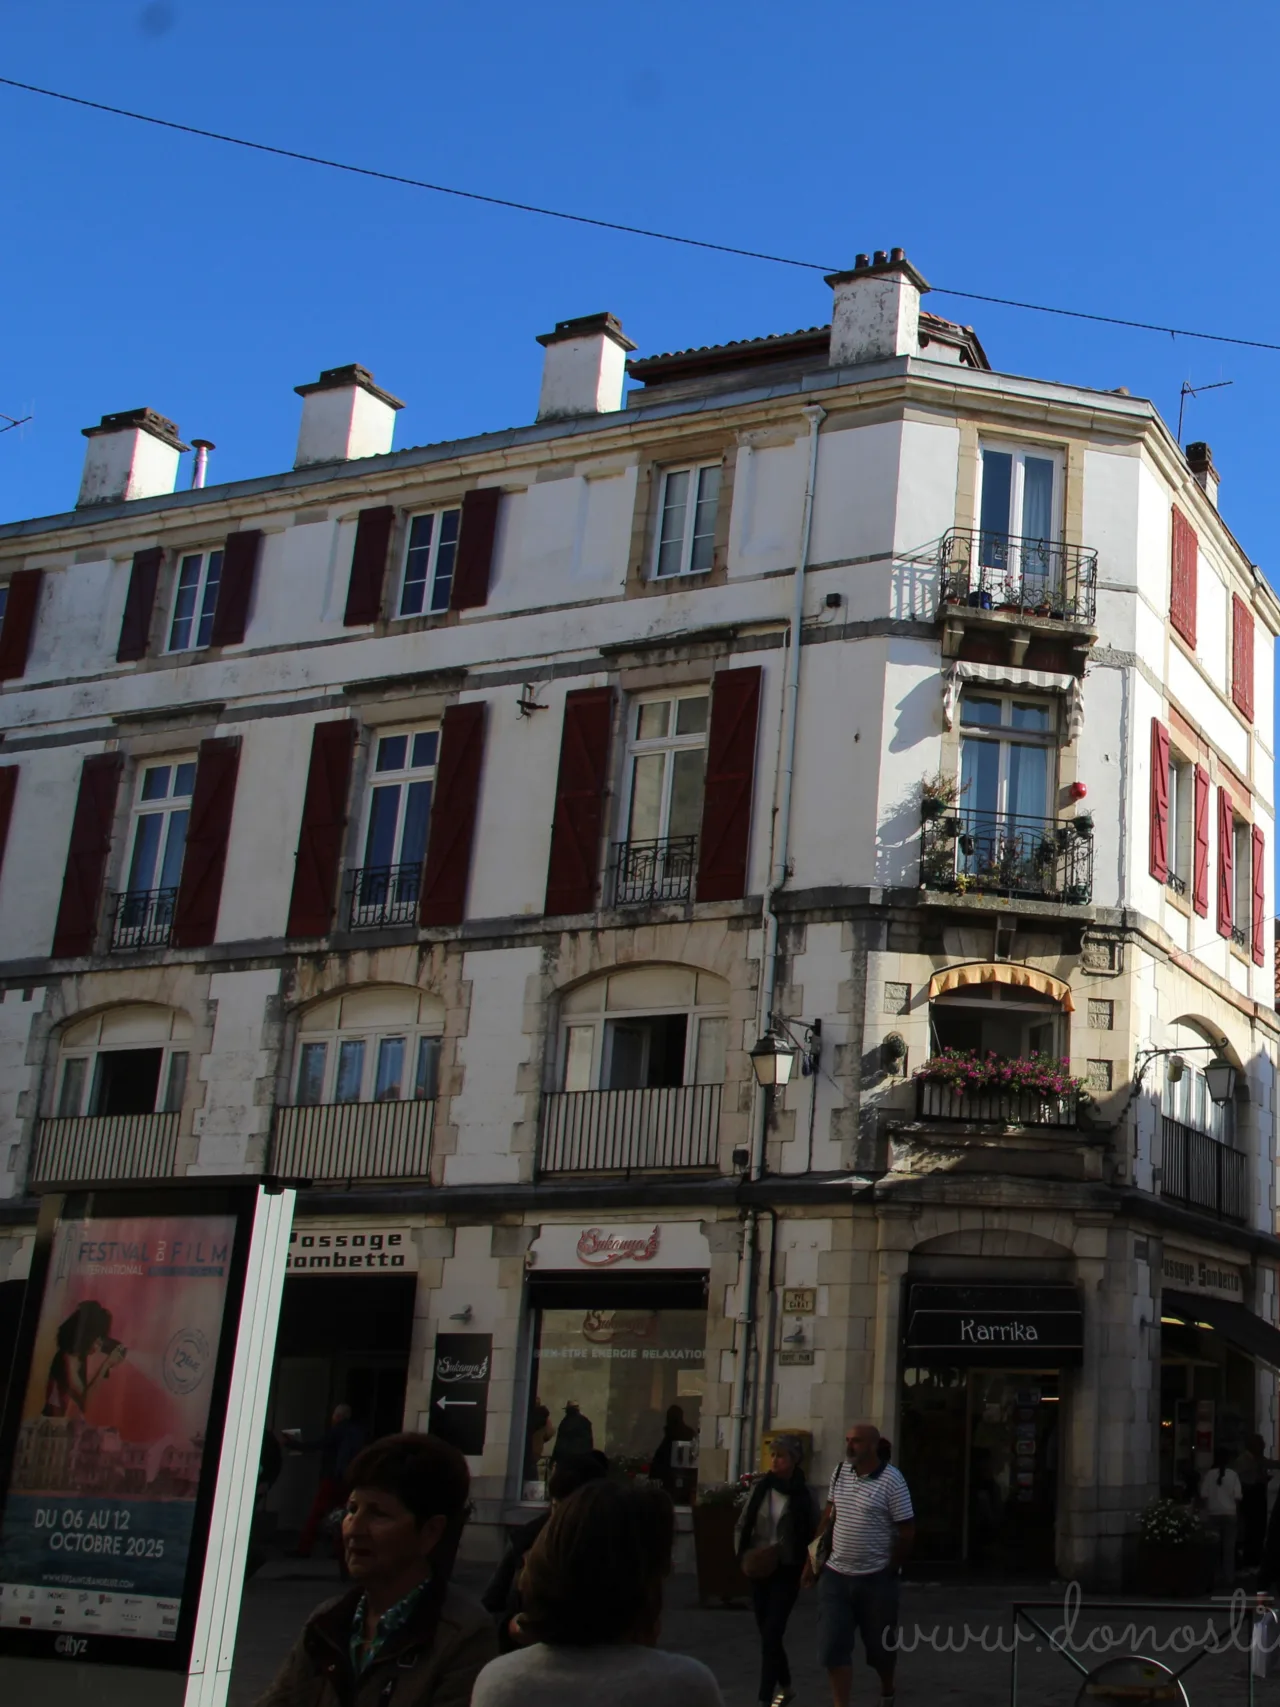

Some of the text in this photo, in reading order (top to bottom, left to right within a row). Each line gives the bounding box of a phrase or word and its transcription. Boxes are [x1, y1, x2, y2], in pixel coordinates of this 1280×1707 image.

[78, 1240, 228, 1263] FESTIVAL DU FILM
[961, 1319, 1038, 1343] Karrika
[34, 1508, 131, 1530] DU 06 AU 12
[49, 1532, 165, 1558] OCTOBRE 2025
[54, 1635, 88, 1656] Cityz
